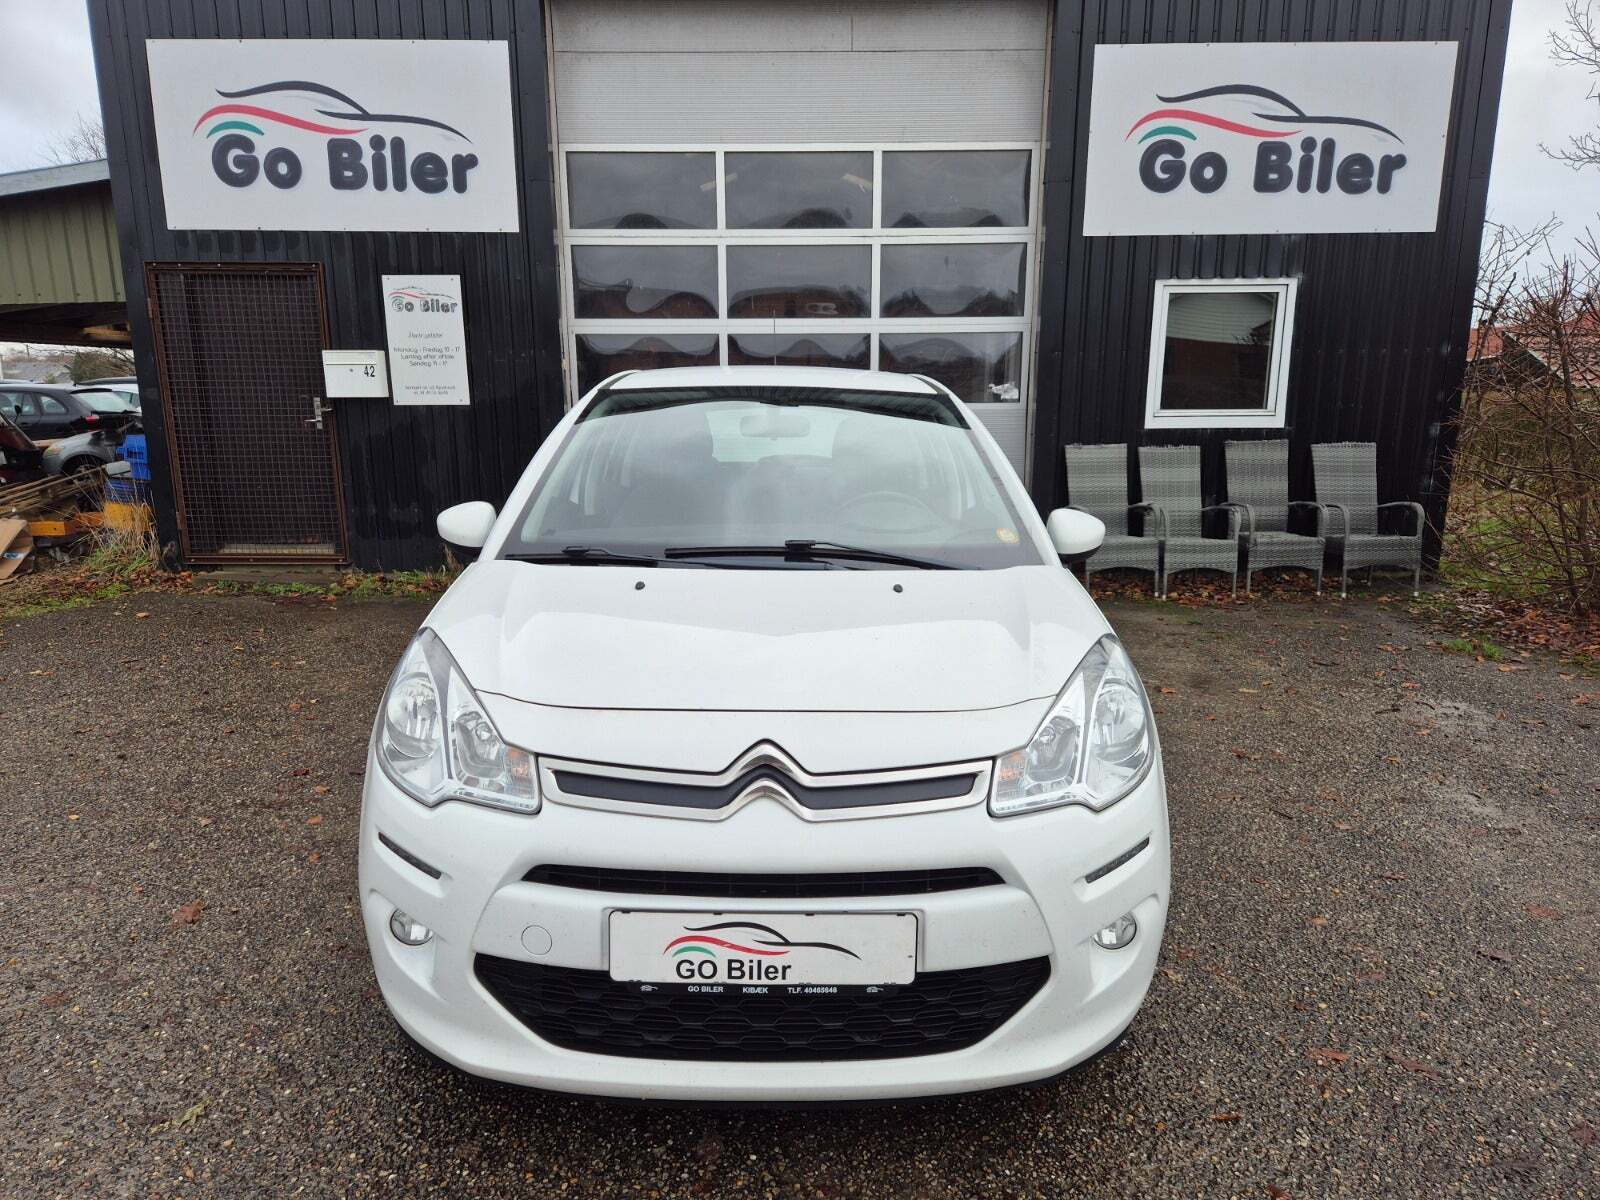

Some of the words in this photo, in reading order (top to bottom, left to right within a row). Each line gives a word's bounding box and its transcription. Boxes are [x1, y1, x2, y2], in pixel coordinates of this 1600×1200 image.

[211, 133, 303, 190] Go
[326, 133, 479, 194] Biler
[1139, 138, 1228, 194] Go
[1253, 136, 1408, 195] Biler
[391, 298, 415, 313] Go
[420, 298, 458, 313] Biler
[363, 365, 376, 378] 42
[675, 959, 718, 980] GO
[727, 958, 792, 981] Biler
[687, 985, 700, 993] GO
[701, 985, 724, 993] BILER
